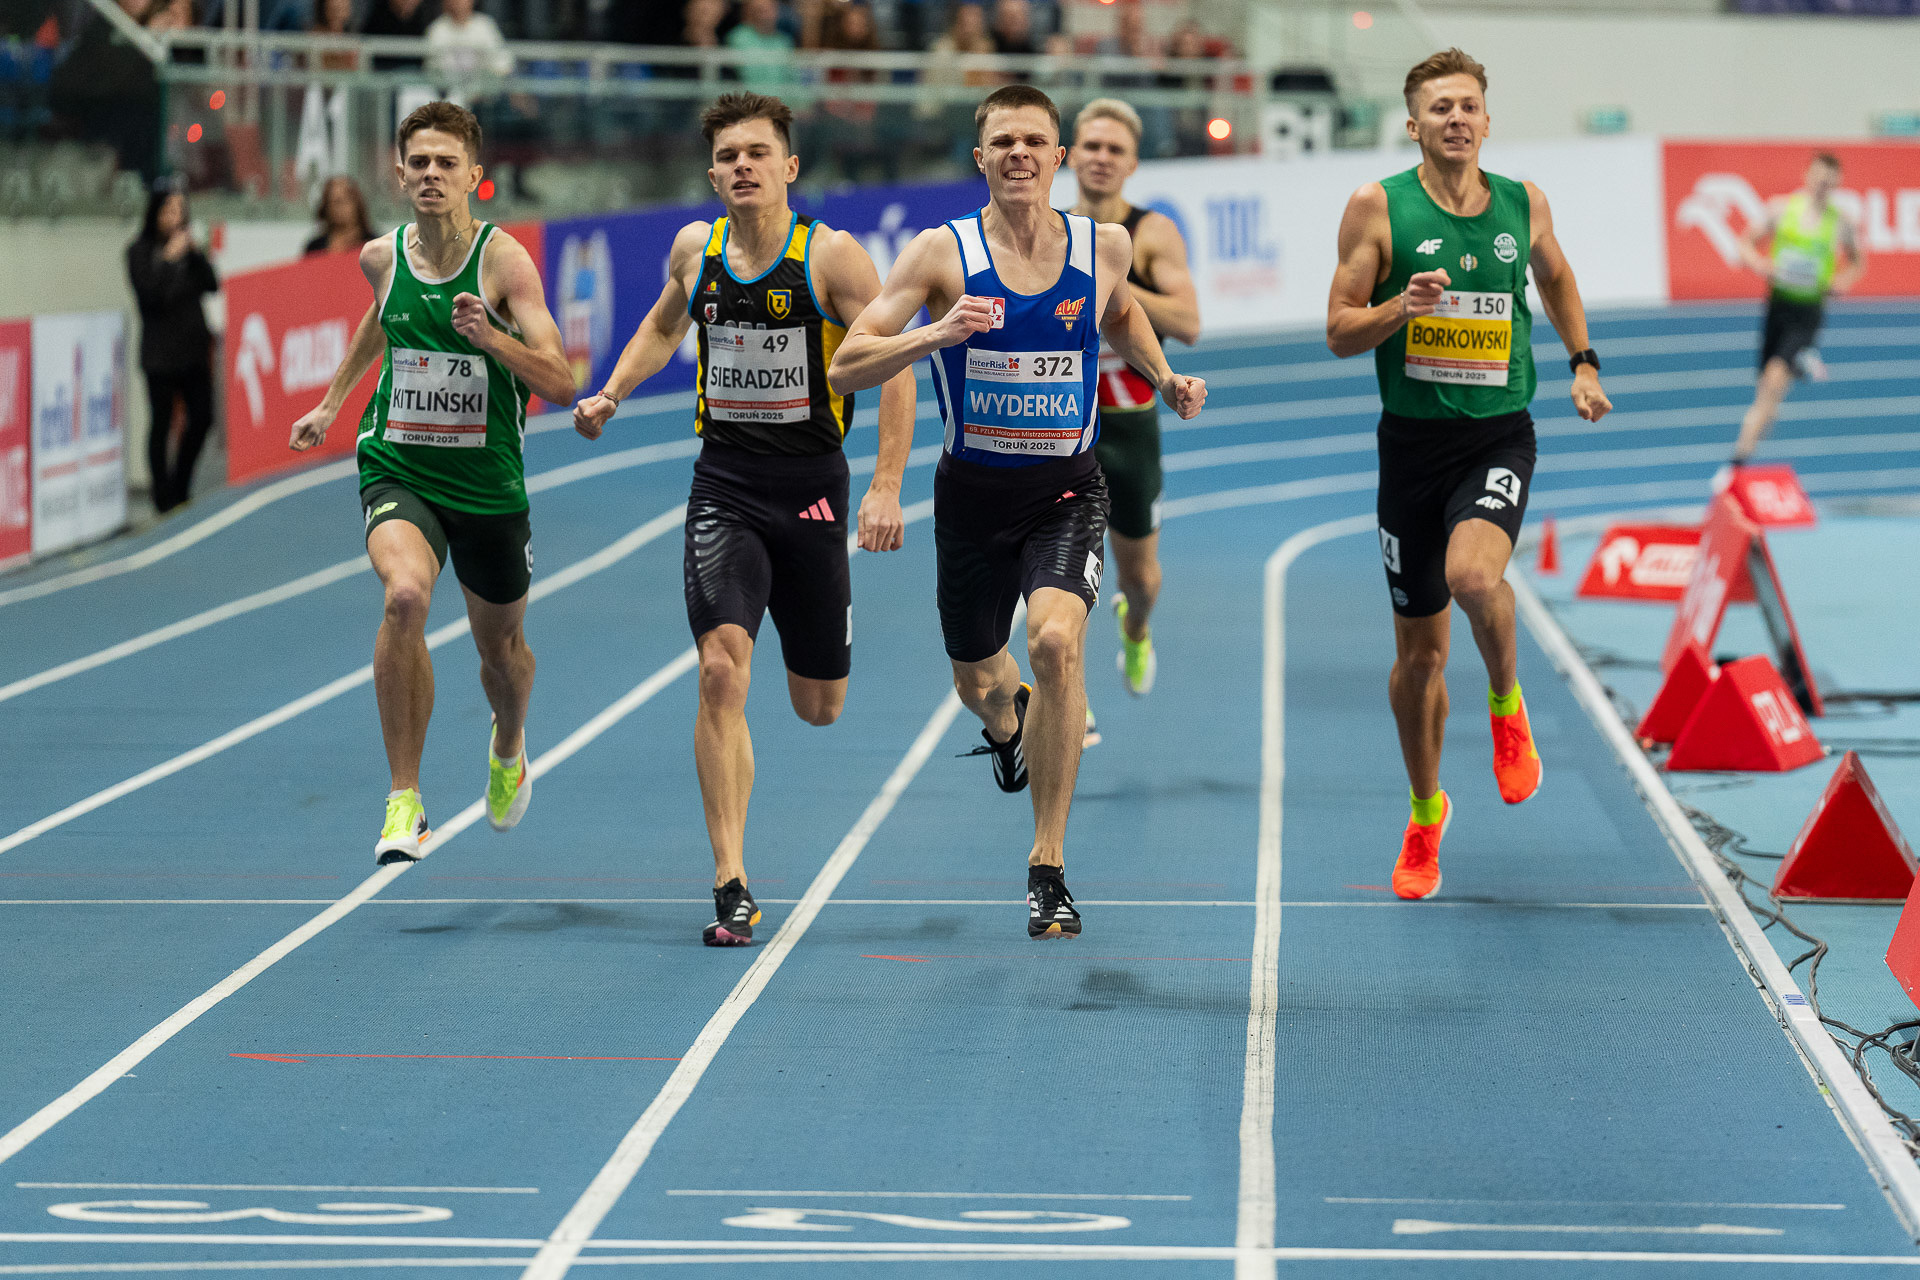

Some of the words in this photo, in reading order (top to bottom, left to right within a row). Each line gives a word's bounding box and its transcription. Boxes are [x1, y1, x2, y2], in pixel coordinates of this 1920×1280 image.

[1416, 238, 1443, 255] 4F
[1055, 296, 1086, 316] AWF
[1473, 296, 1505, 315] 150
[762, 334, 789, 353] 49
[1412, 325, 1508, 350] BORKOWSKI
[447, 358, 472, 378] 78
[969, 358, 1008, 370] InterRisk
[1033, 356, 1074, 377] 372
[710, 365, 805, 389] SIERADZKI
[1465, 371, 1486, 380] 2025
[393, 387, 483, 413] KITLIŃSKI
[970, 390, 1079, 417] WYDERKA
[727, 410, 759, 420] TORUŃ
[761, 412, 784, 420] 2025
[402, 434, 434, 443] TORUŃ
[436, 435, 460, 444] 2025
[969, 425, 980, 433] 69.
[996, 430, 1021, 438] Halowe
[992, 440, 1028, 450] TORUŃ
[1029, 442, 1056, 451] 2025
[1495, 474, 1514, 496] 4
[1384, 537, 1395, 567] 4
